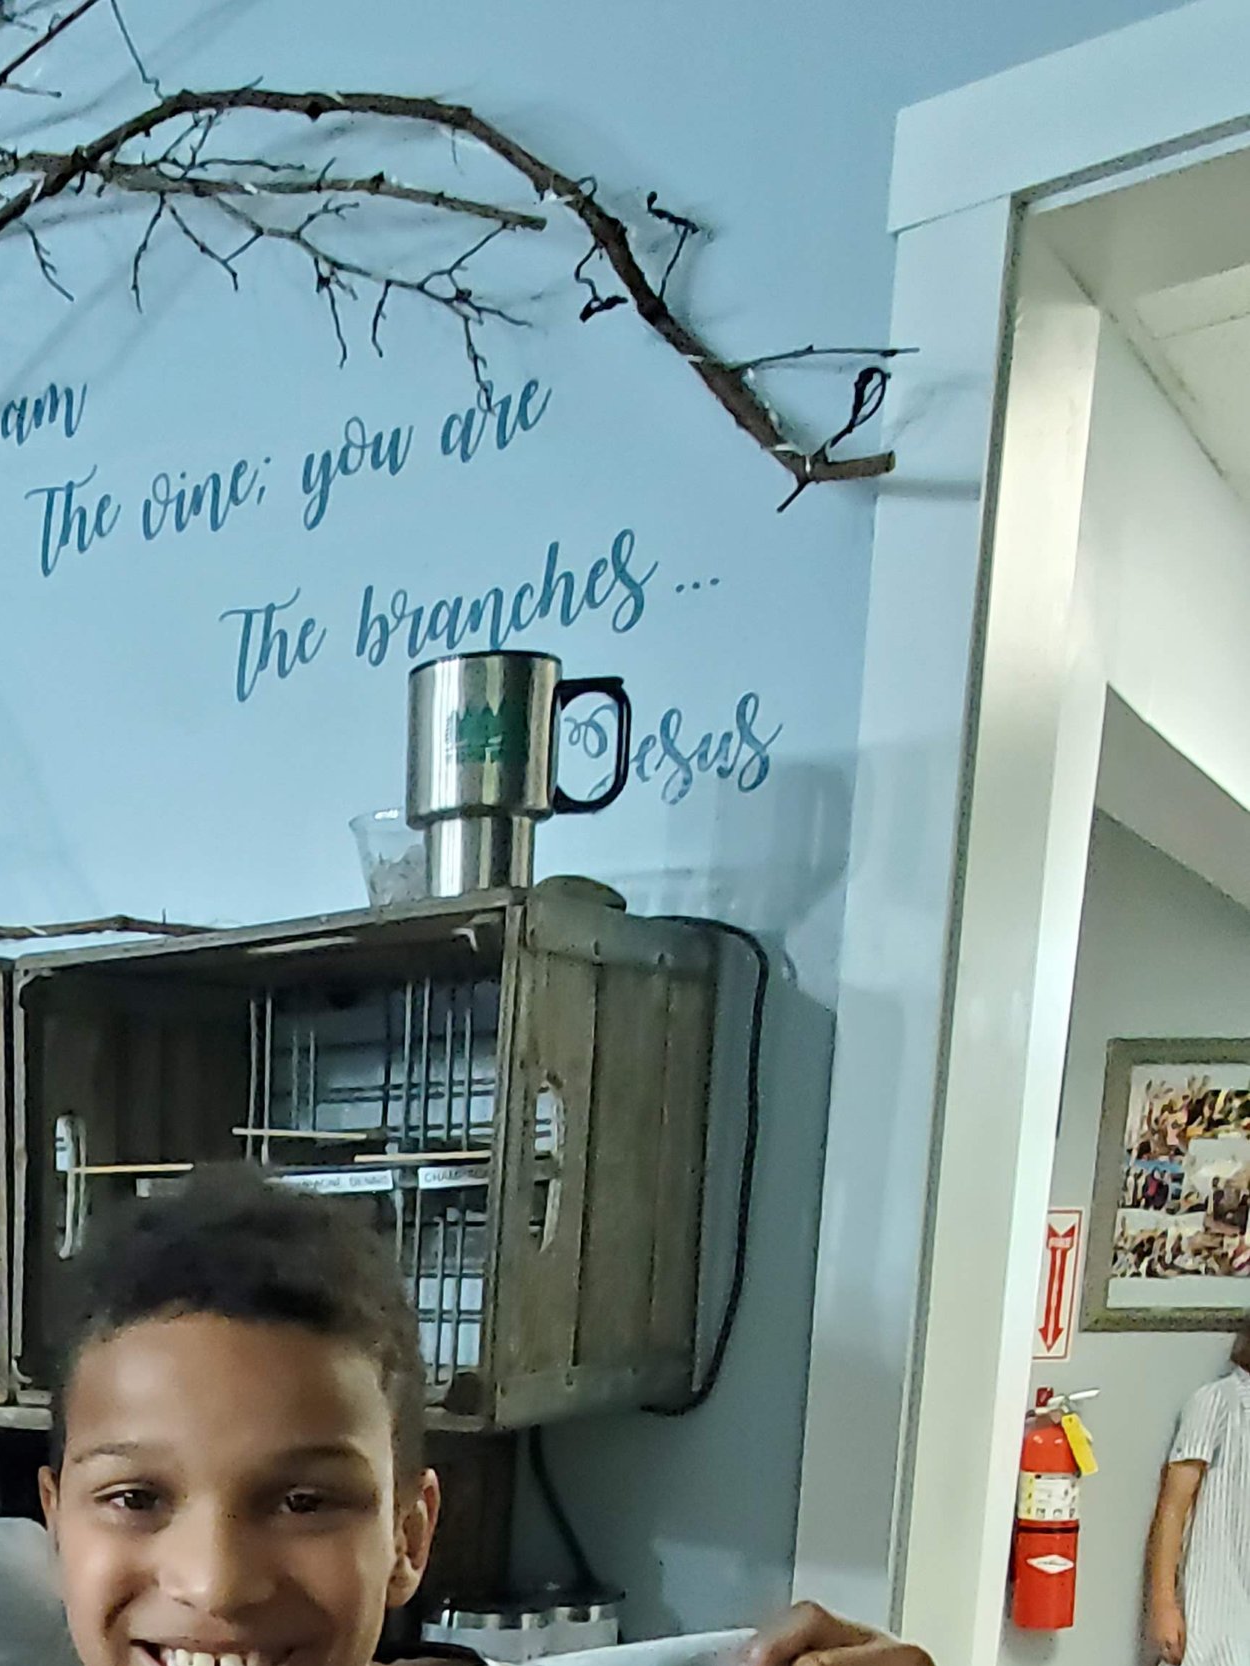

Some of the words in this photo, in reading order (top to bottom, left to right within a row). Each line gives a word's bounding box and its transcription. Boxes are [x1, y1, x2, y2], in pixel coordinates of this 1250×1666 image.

[0, 381, 88, 446] am
[23, 463, 122, 578] The
[141, 456, 273, 541] vine;
[301, 415, 415, 531] you
[439, 378, 553, 464] are
[218, 585, 328, 702] The
